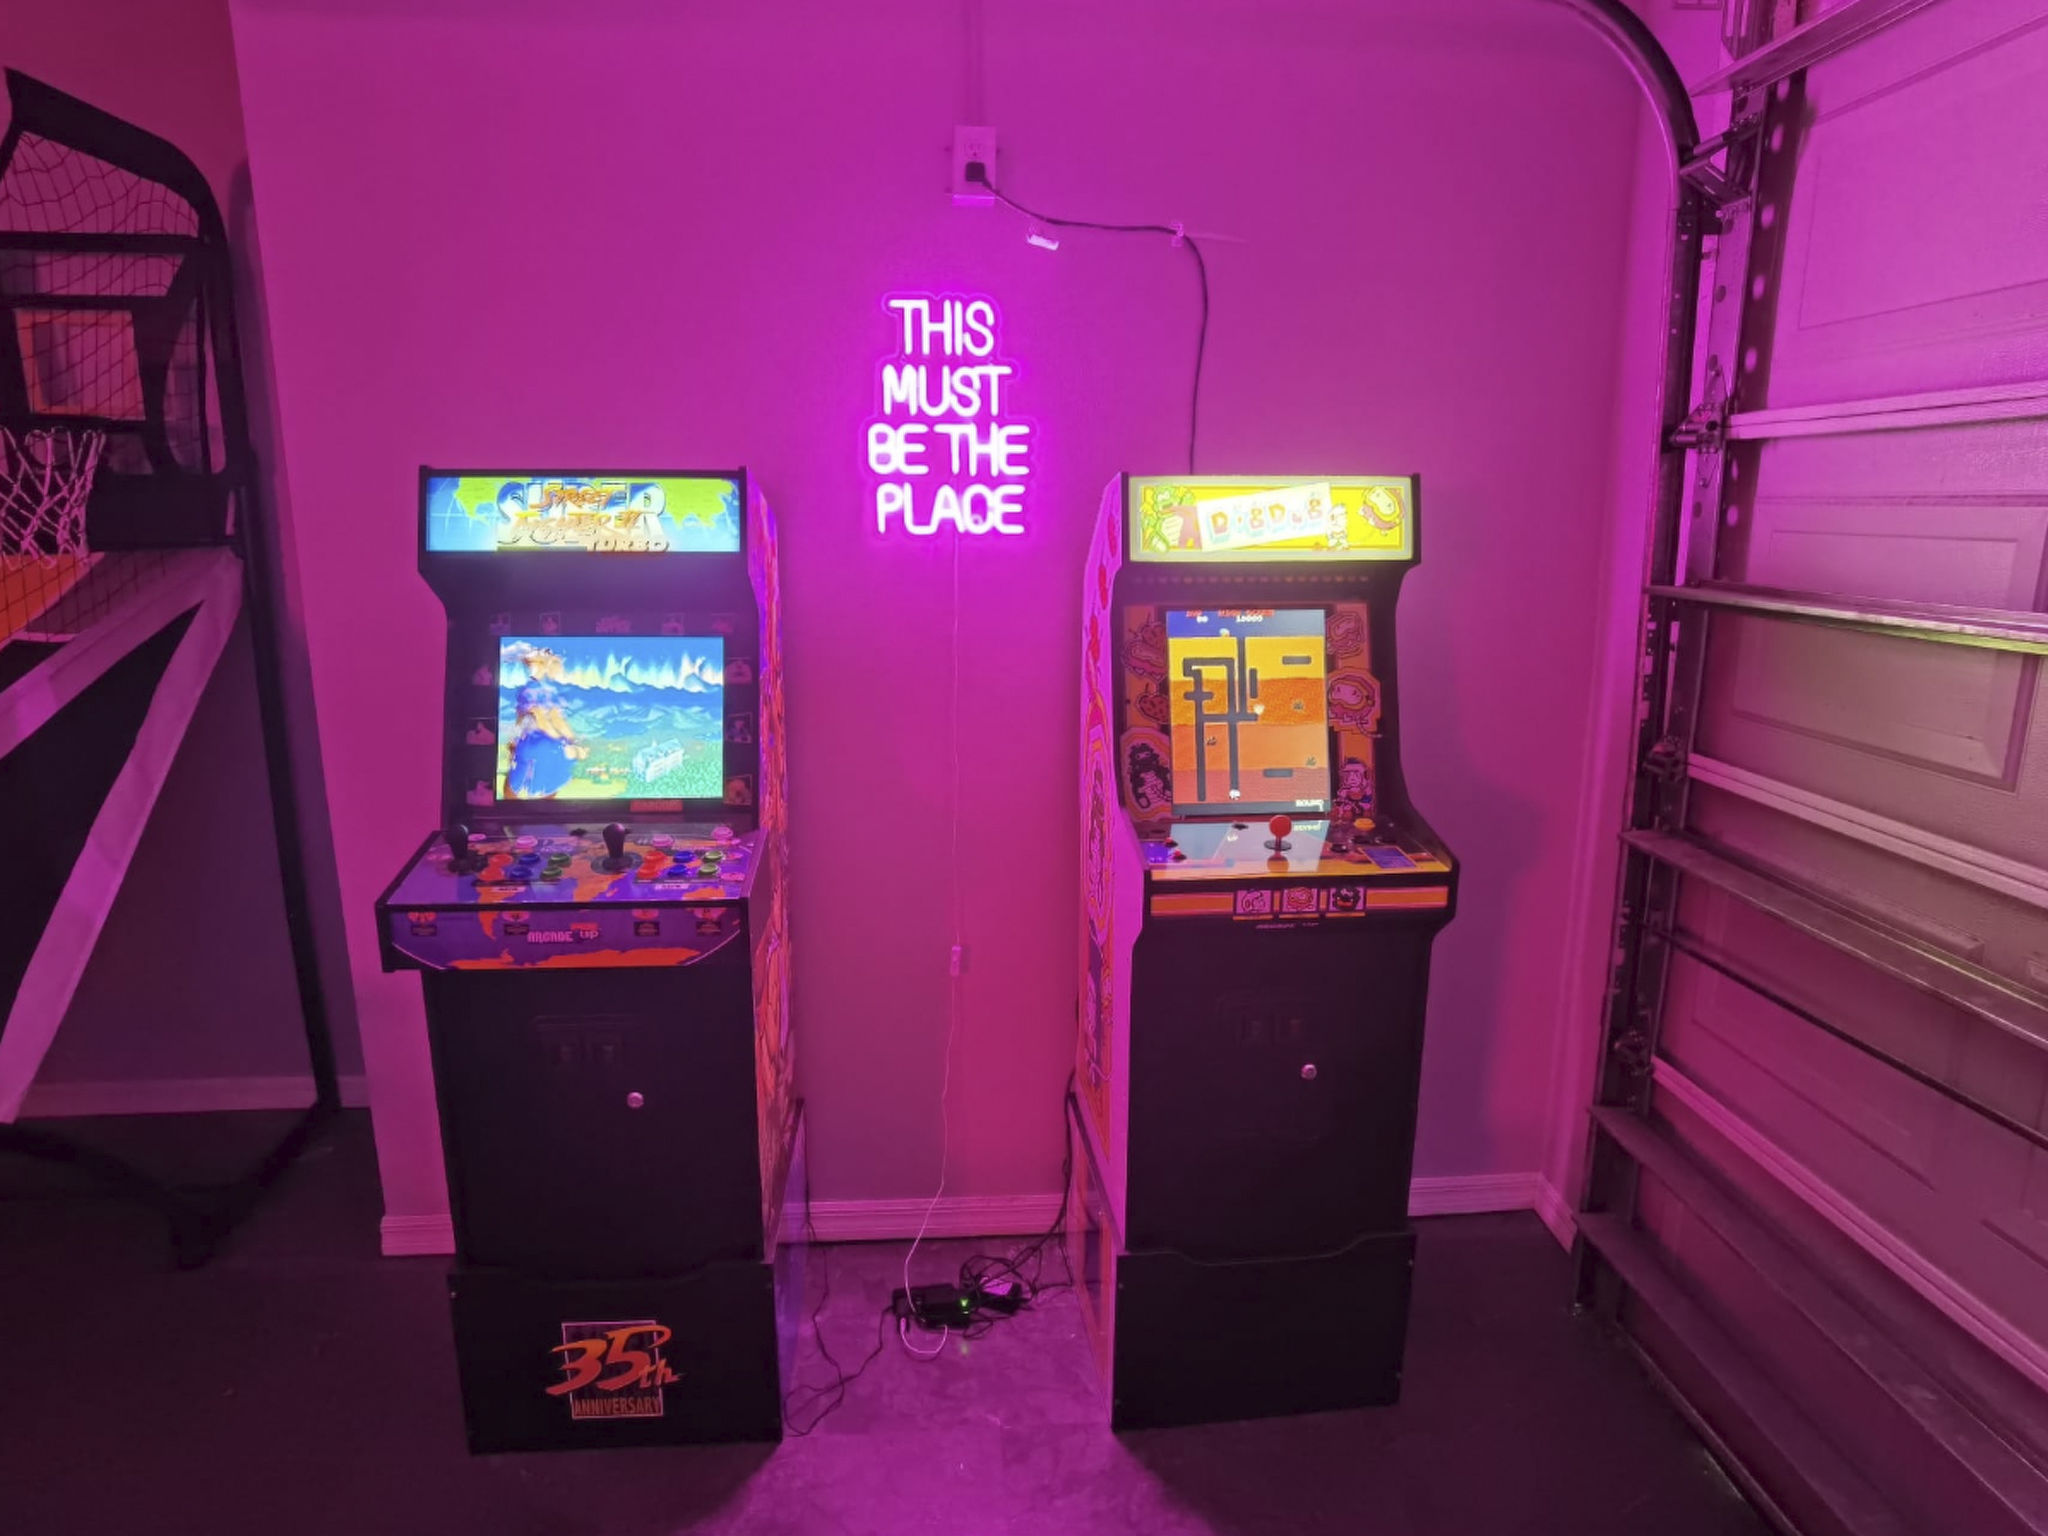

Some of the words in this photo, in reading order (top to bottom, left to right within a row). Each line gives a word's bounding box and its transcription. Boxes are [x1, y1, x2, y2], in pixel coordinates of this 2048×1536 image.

[888, 299, 995, 357] THIS
[882, 364, 1012, 418] MUST
[867, 422, 929, 475] BE
[933, 421, 1031, 478] THE
[876, 482, 1026, 535] PLACE
[575, 1396, 660, 1415] ANNIVERSARY
